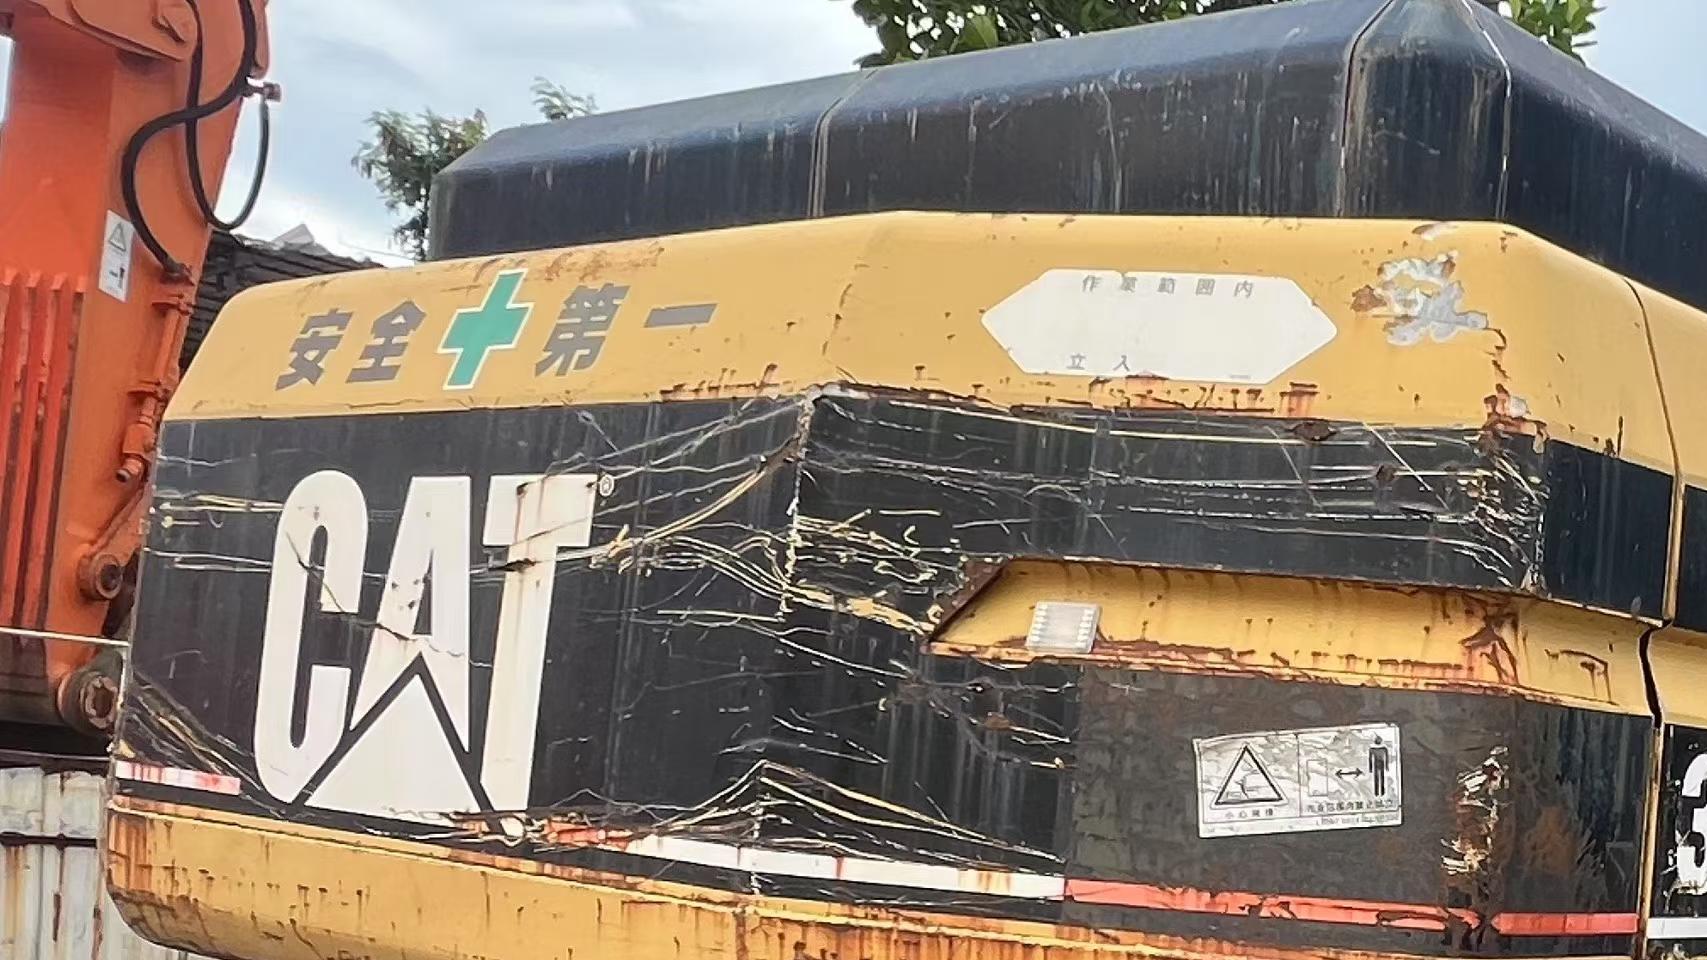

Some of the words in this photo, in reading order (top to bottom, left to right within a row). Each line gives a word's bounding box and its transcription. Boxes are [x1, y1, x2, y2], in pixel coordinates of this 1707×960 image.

[274, 300, 428, 391] 安全
[534, 283, 717, 379] 第一
[1066, 353, 1131, 372] 立入
[253, 469, 600, 812] CAT
